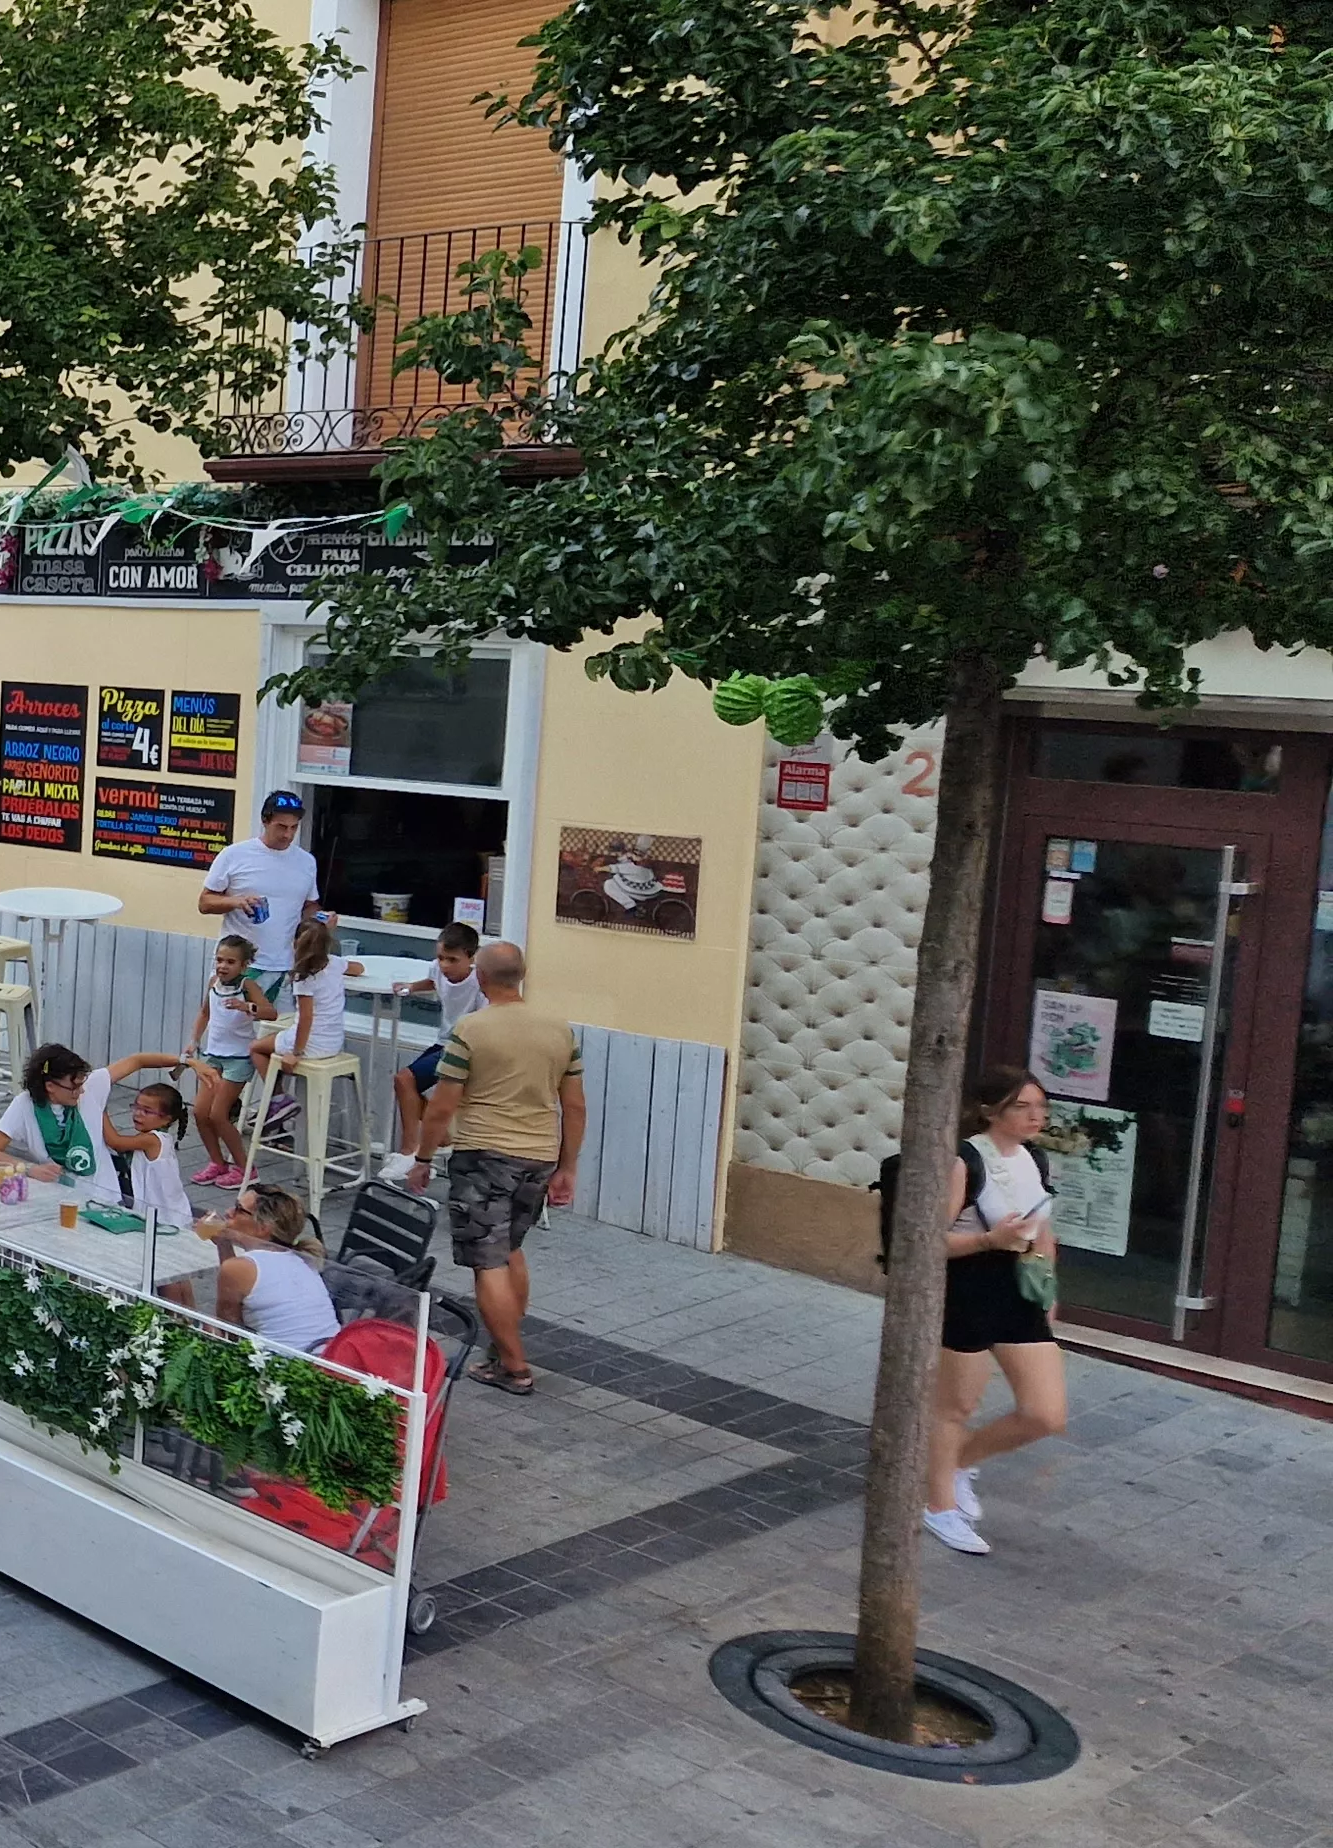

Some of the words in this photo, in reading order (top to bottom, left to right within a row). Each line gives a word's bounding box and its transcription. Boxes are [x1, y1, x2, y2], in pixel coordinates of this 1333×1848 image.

[25, 524, 99, 556] PIZZAS
[321, 549, 360, 561] PARA
[31, 558, 86, 575] masa
[108, 566, 143, 588] CON
[147, 565, 199, 589] AMOR
[21, 576, 95, 594] casera
[5, 690, 81, 718] Arroces
[101, 688, 160, 722] Pizza
[173, 693, 216, 714] MENÚS
[101, 718, 110, 730] al
[111, 720, 135, 732] corte
[172, 715, 188, 733] DEL
[190, 713, 205, 734] DÍA
[4, 741, 40, 759] ARROZ
[43, 743, 80, 762] NEGRO
[25, 759, 80, 783] SEÑORITO
[783, 763, 826, 777] Alarma
[901, 751, 936, 797] 2
[44, 783, 80, 801] MIXTA
[99, 785, 160, 809] vermú
[1, 796, 80, 820] PRUÉBALOS
[1, 812, 10, 822] TE
[11, 813, 26, 823] VAS
[26, 815, 33, 824] A
[33, 816, 62, 828] CHUPAR
[96, 819, 124, 830] TORTILLA
[1, 823, 25, 838] LOS
[26, 826, 66, 844] DEDOS
